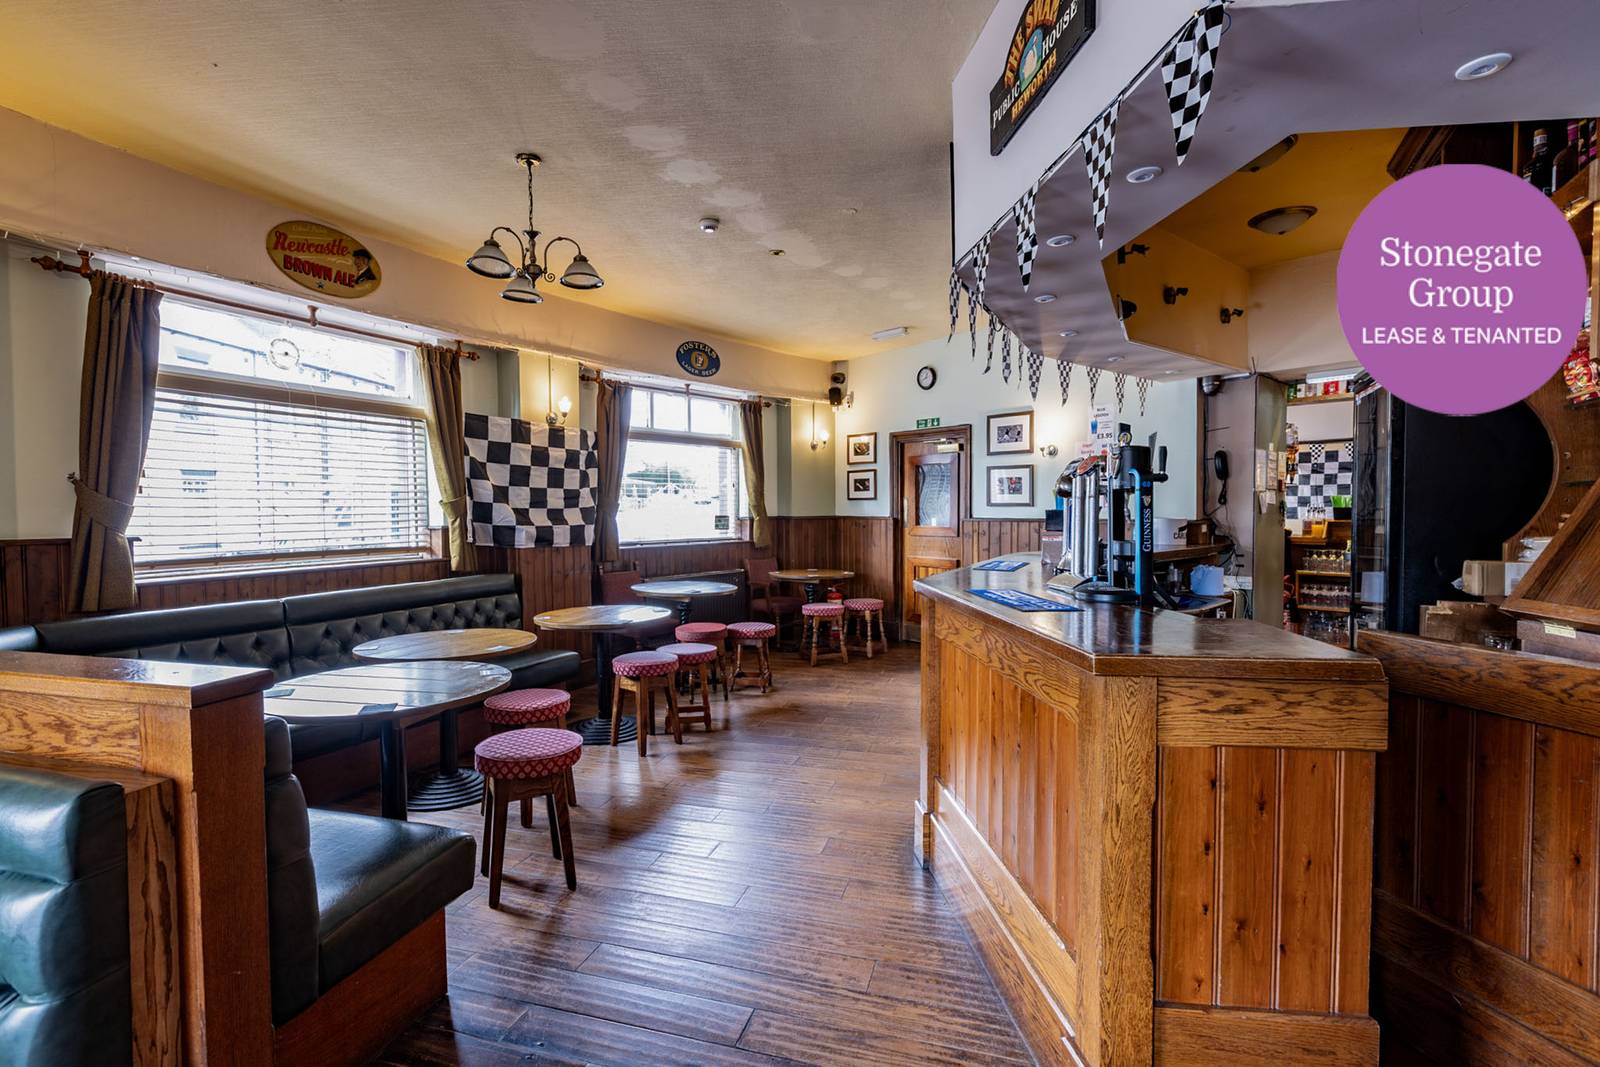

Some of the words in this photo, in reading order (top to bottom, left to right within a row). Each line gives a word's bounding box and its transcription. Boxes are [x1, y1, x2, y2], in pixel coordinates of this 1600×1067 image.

[992, 80, 1021, 130] PUBLIC
[1042, 0, 1079, 60] HOUSE
[1004, 26, 1025, 90] THE
[1010, 48, 1057, 123] HEWORTH
[273, 230, 350, 257] Newcastle
[283, 254, 333, 282] BROWN
[333, 270, 355, 288] ALE
[1142, 508, 1152, 552] GUINNESS
